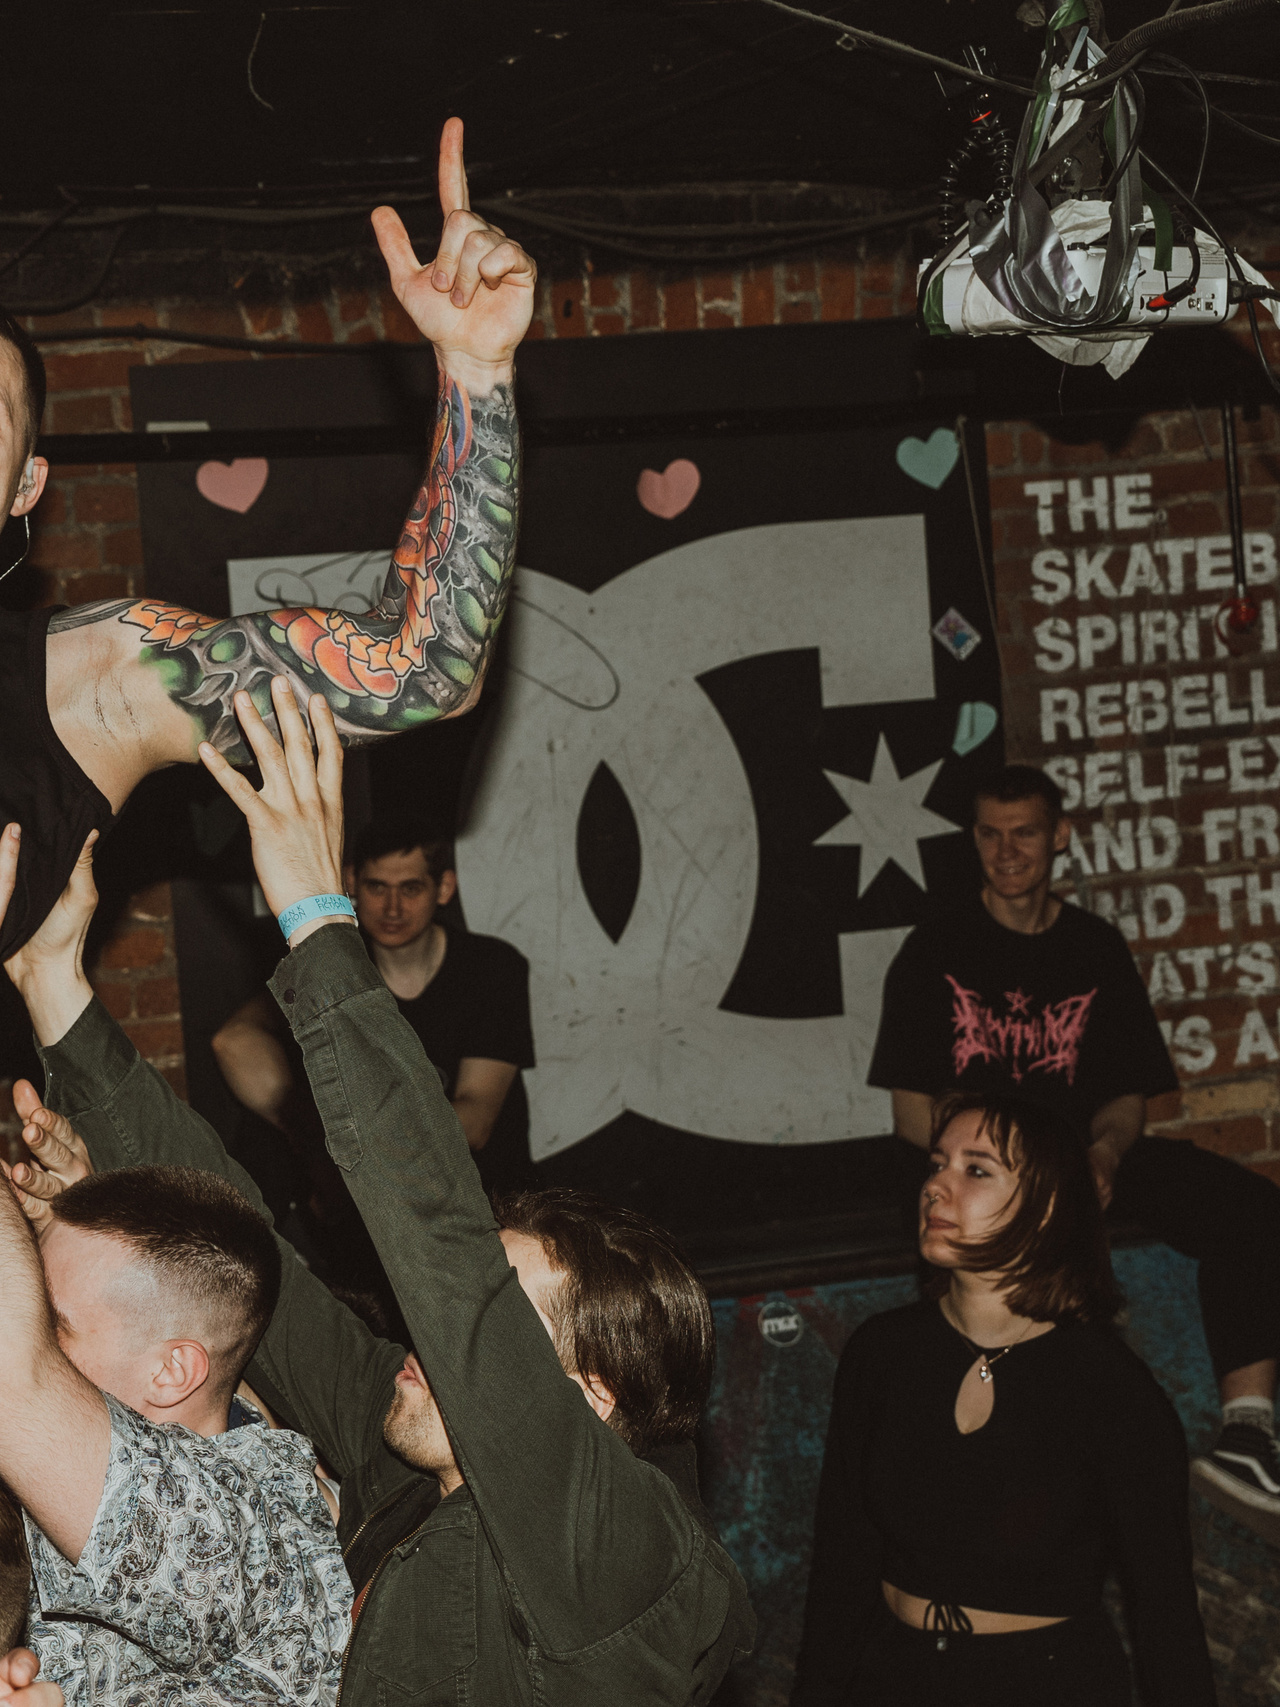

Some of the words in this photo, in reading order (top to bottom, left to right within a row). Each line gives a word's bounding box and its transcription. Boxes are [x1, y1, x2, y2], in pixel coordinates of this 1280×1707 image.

[1024, 473, 1153, 535] THE
[1031, 532, 1278, 604] SKATEB
[1033, 602, 1234, 673] SPIRIT
[1051, 815, 1182, 880] AND
[1064, 883, 1187, 940] ND
[1133, 941, 1278, 1004] AT'S
